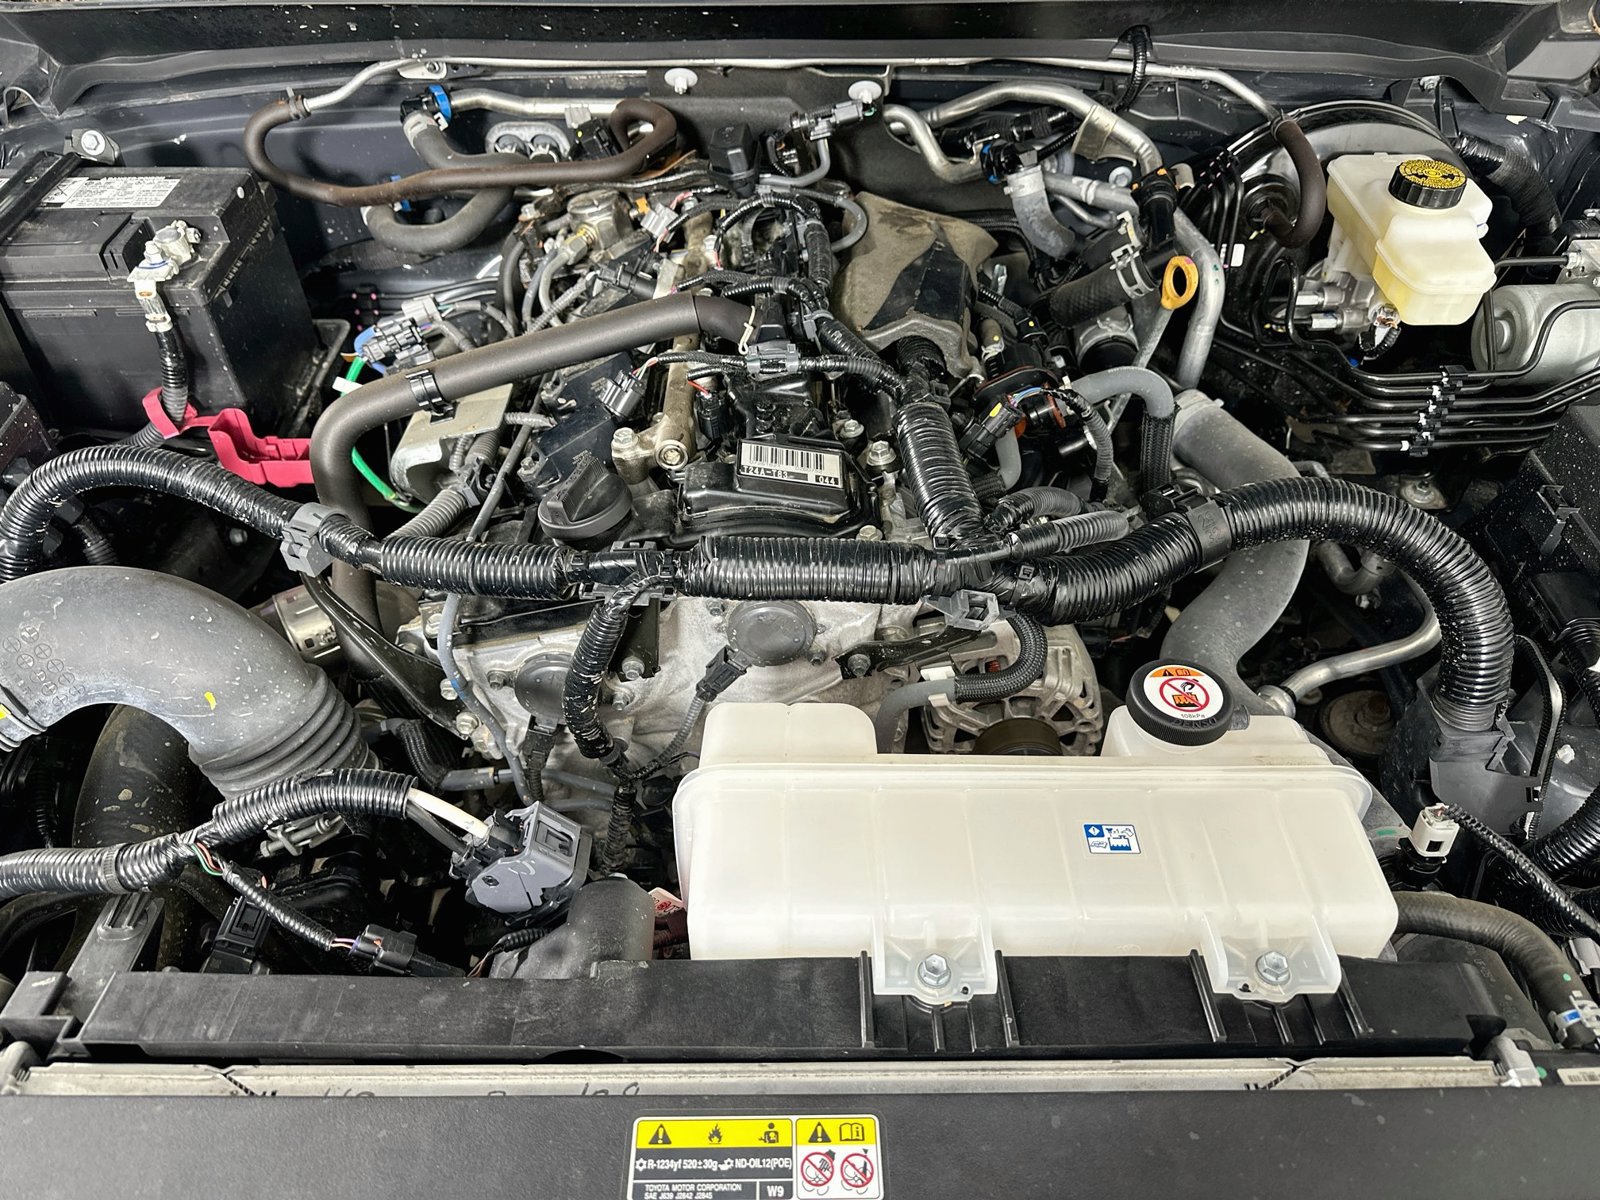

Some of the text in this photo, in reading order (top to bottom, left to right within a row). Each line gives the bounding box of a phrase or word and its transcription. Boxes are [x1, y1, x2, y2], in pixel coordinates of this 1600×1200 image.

[743, 465, 788, 479] T24A-T83
[818, 475, 836, 485] 044
[647, 1157, 792, 1171] R-1234yf 520±30g ND-OIL12(POE)
[644, 1183, 742, 1192] TOYOTA MOTOR CORPORATION
[766, 1185, 785, 1197] W9
[643, 1192, 657, 1200] SAE
